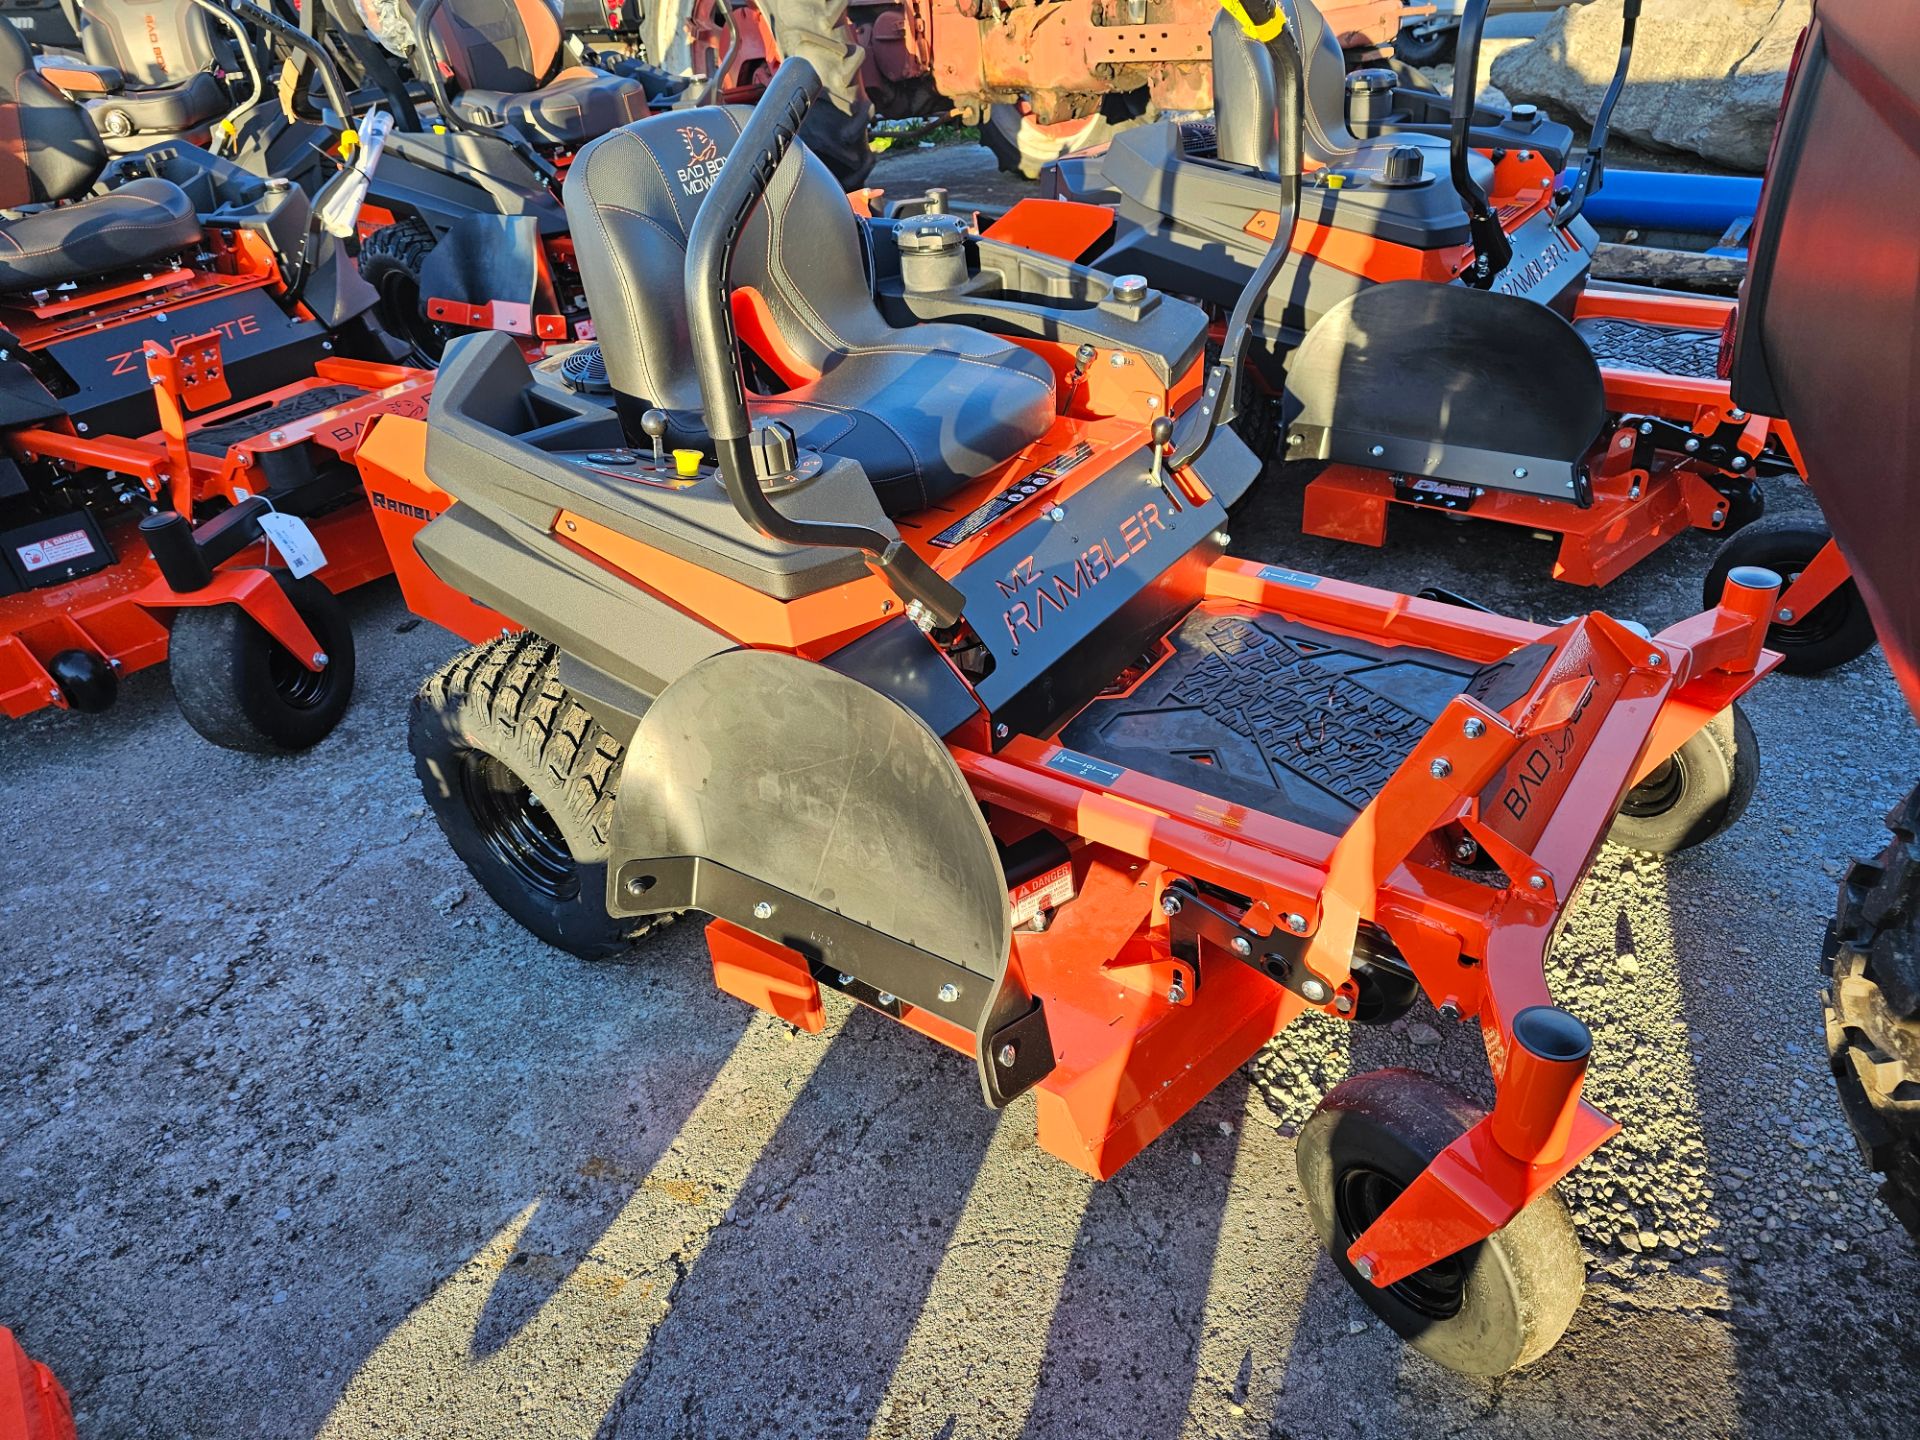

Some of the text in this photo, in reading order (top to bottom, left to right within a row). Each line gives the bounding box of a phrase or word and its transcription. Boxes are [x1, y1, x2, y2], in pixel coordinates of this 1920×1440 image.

[144, 15, 169, 75] BAD BOY
[677, 164, 705, 183] BAD
[1501, 243, 1564, 297] RAMBLER
[331, 421, 367, 442] BA
[371, 490, 441, 522] RAMBL
[53, 532, 84, 546] DANGER
[995, 555, 1044, 599] MZ
[1003, 503, 1166, 646] RAMBLER
[1503, 749, 1552, 821] BAD
[1032, 866, 1070, 890] DANGER
